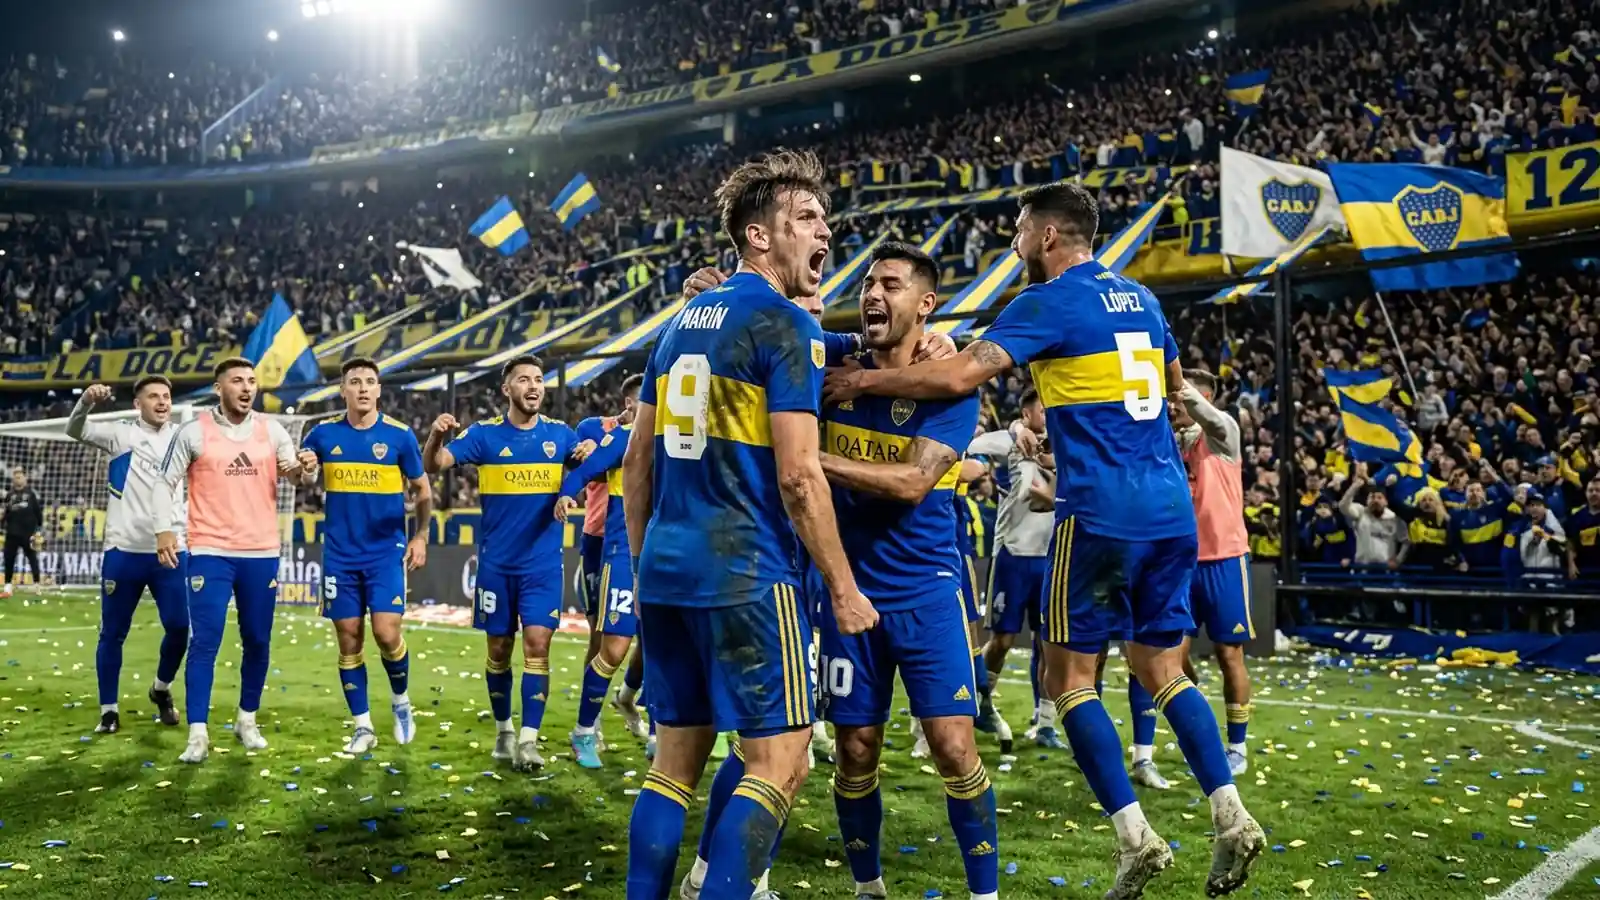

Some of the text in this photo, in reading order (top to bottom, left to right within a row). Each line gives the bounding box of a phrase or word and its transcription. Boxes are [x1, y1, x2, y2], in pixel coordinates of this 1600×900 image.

[837, 12, 1006, 69] DOCE
[1525, 147, 1600, 211] 12
[678, 301, 729, 330] MARÍN
[1099, 288, 1145, 313] LÓPEZ
[52, 353, 104, 381] LA
[119, 347, 221, 378] DOCE
[1113, 332, 1163, 421] 5
[664, 354, 711, 460] 9
[836, 434, 900, 462] QATAR
[504, 470, 550, 483] QATAR
[610, 588, 632, 614] 12
[821, 654, 853, 697] 10
